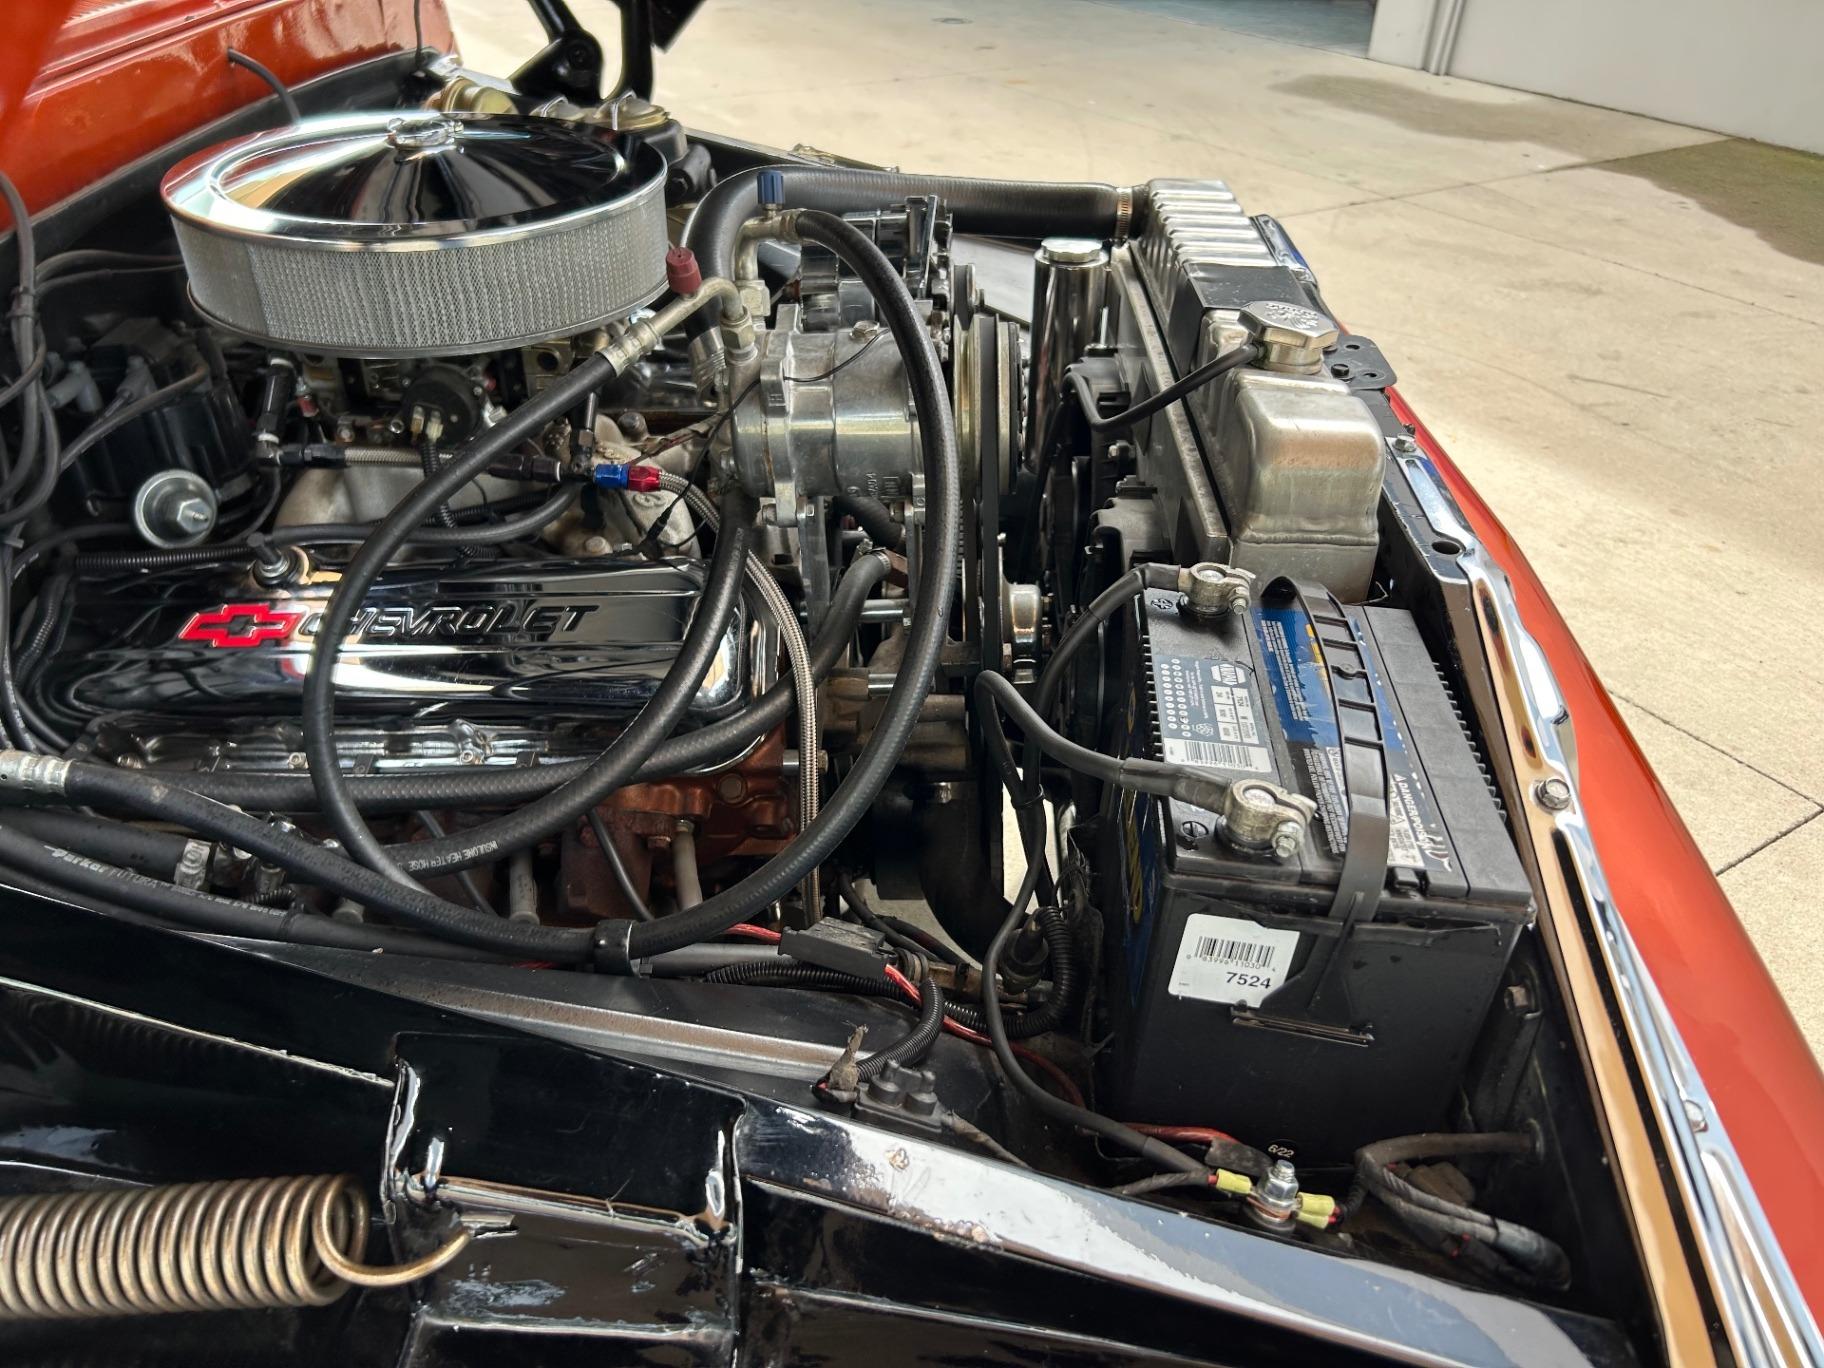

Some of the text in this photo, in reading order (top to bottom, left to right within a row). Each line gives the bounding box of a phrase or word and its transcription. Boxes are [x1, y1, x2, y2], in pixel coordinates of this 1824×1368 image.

[408, 858, 430, 873] HOSE
[431, 852, 463, 868] HEATER
[1226, 971, 1272, 989] 7524
[1268, 1144, 1295, 1158] 6/22
